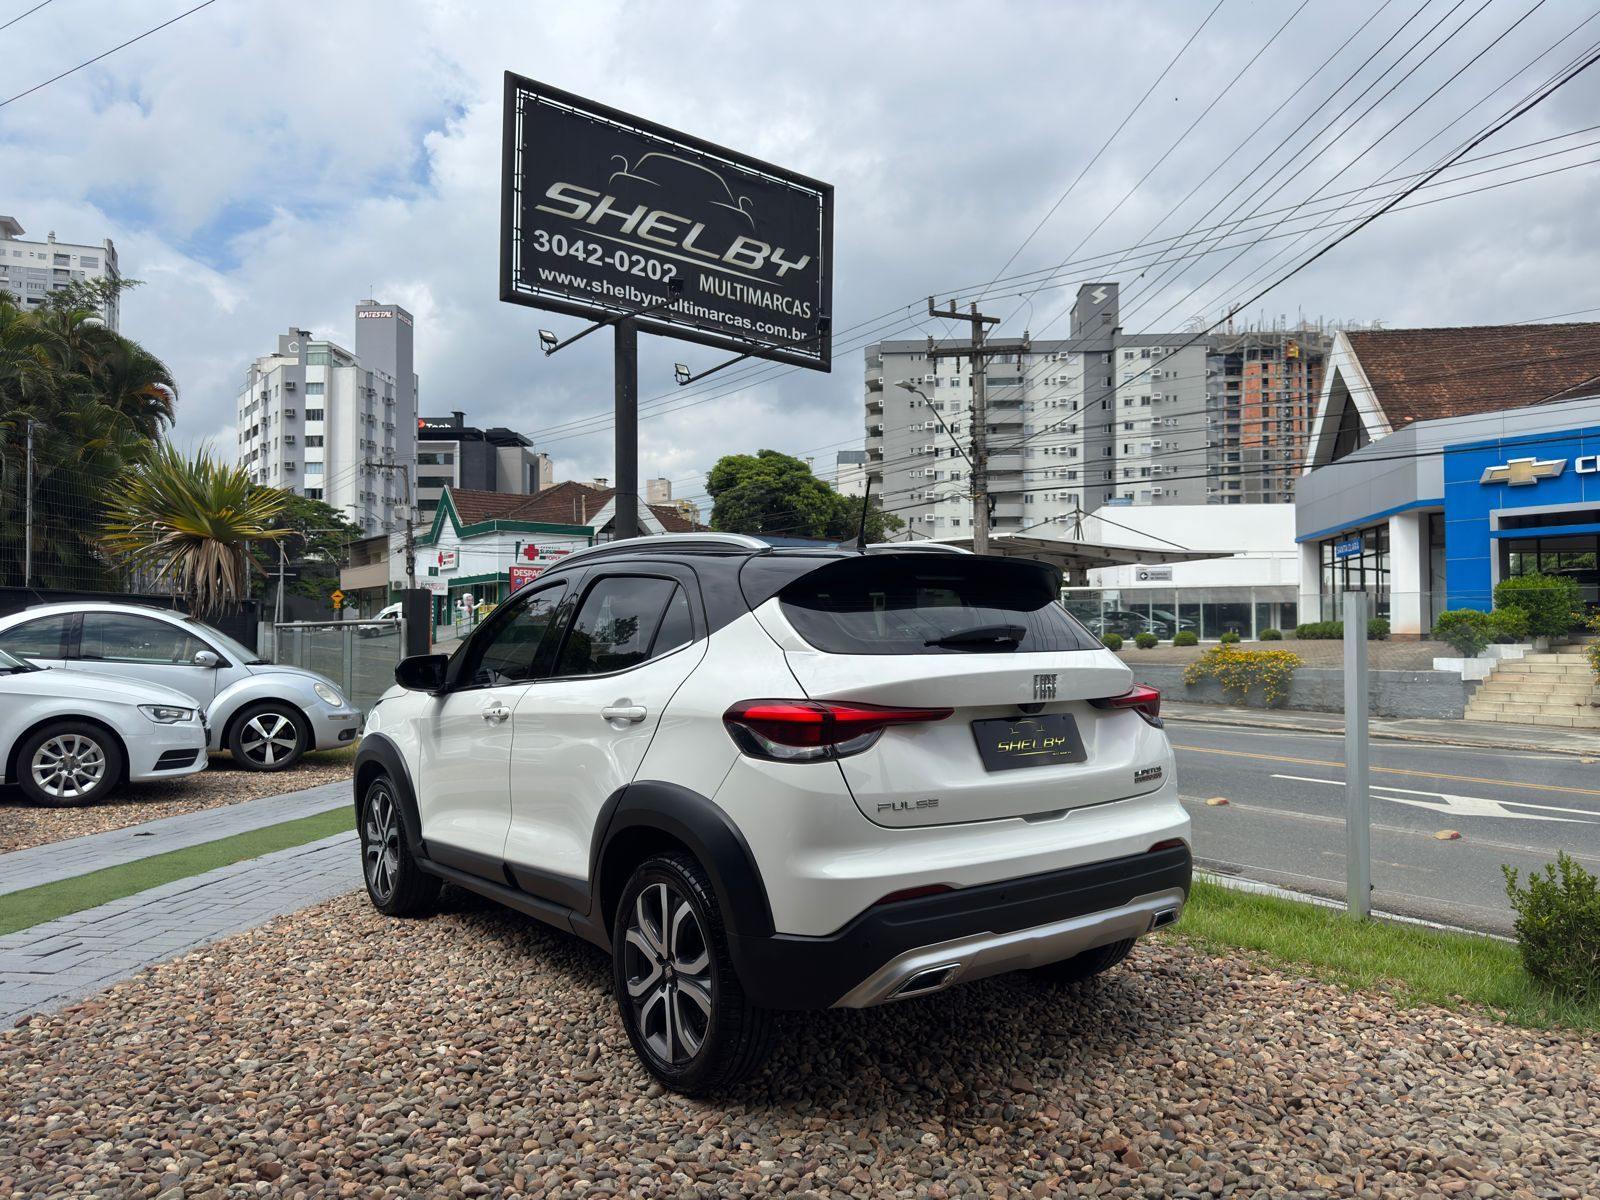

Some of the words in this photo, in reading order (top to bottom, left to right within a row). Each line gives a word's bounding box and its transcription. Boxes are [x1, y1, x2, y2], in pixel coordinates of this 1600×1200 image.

[534, 181, 812, 277] SHELBY
[533, 229, 678, 284] 3042-0202
[538, 267, 808, 341] www.shelbymultimarcas.com.br
[699, 273, 811, 319] MULTIMARCAS
[997, 736, 1066, 753] SHELBY
[877, 798, 939, 812] PULSE
